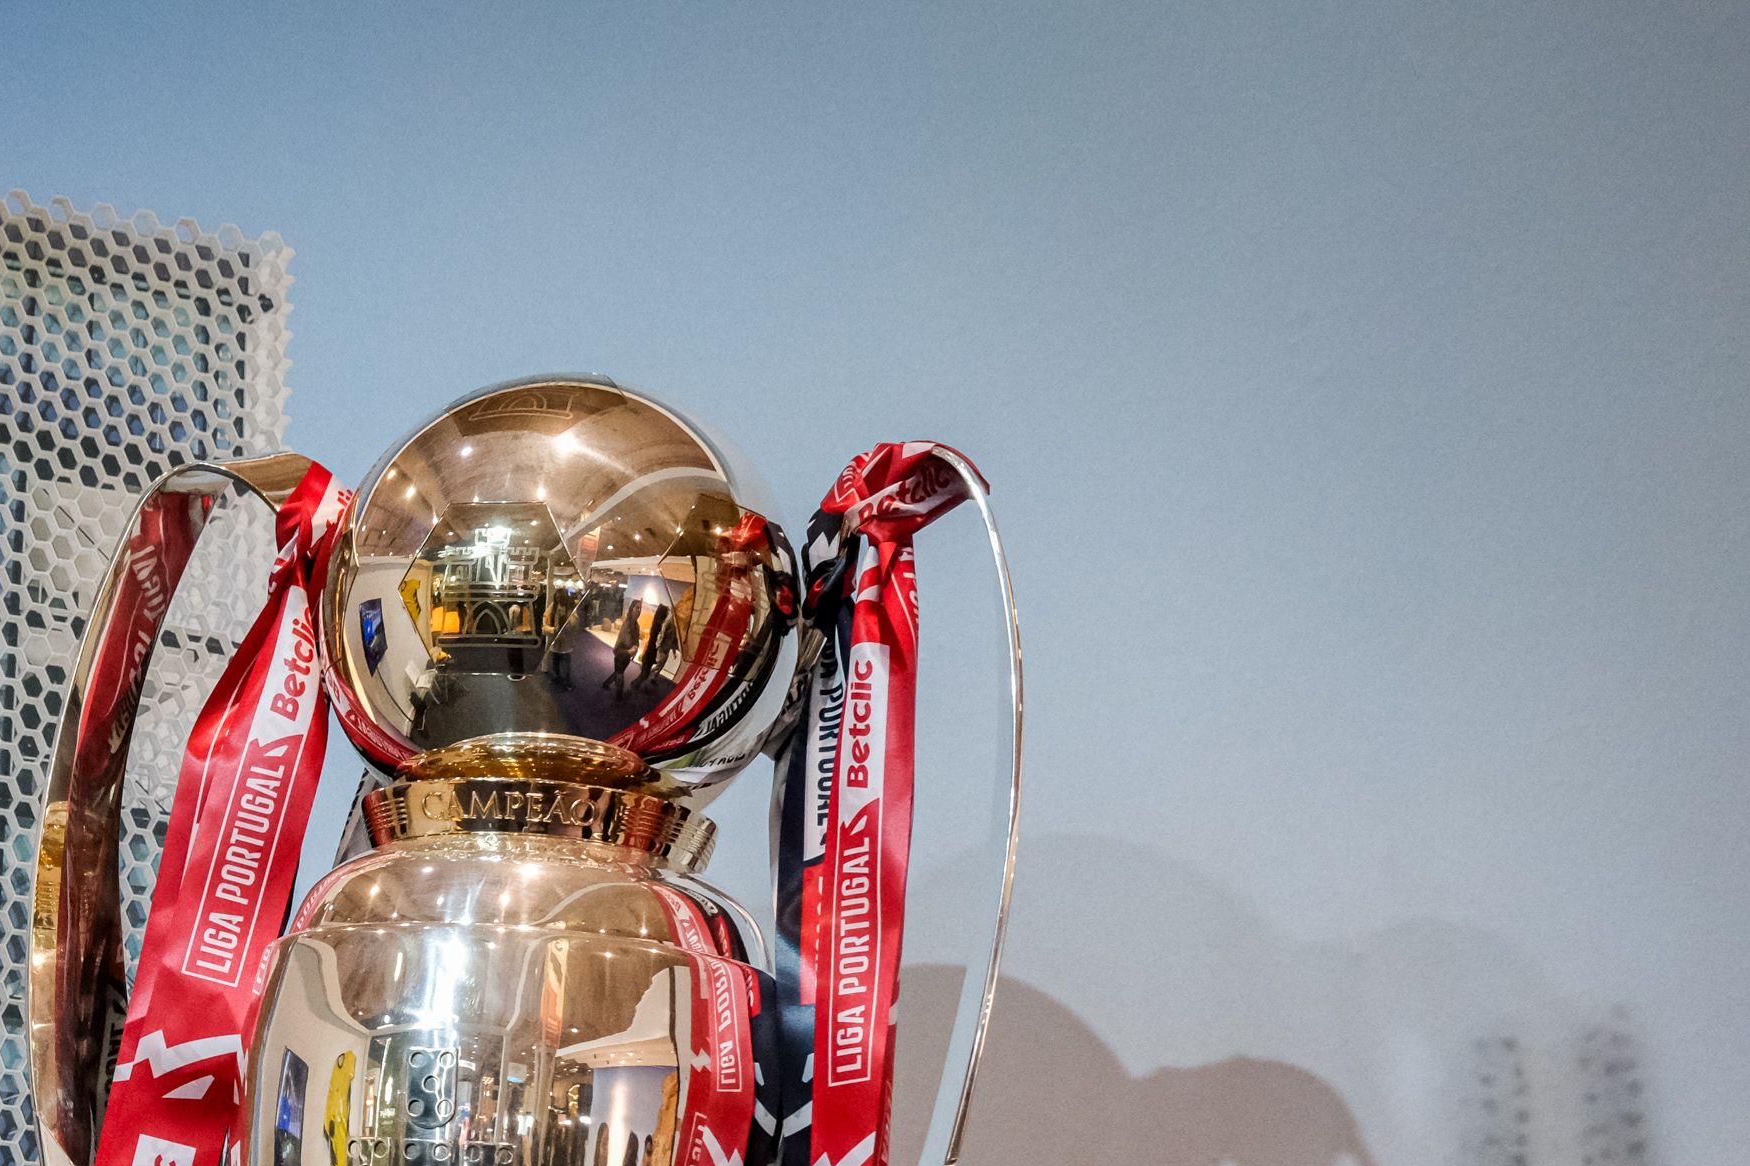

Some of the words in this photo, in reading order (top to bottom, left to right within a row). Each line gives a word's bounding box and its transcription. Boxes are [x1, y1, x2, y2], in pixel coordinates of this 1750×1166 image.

[846, 658, 873, 789] Betclic
[216, 764, 286, 905] PORTUGAL
[421, 788, 599, 828] CAMPEÃO
[196, 910, 244, 974] LIGA
[838, 836, 871, 999] PORTUGAL
[836, 1005, 864, 1074] LIGA
